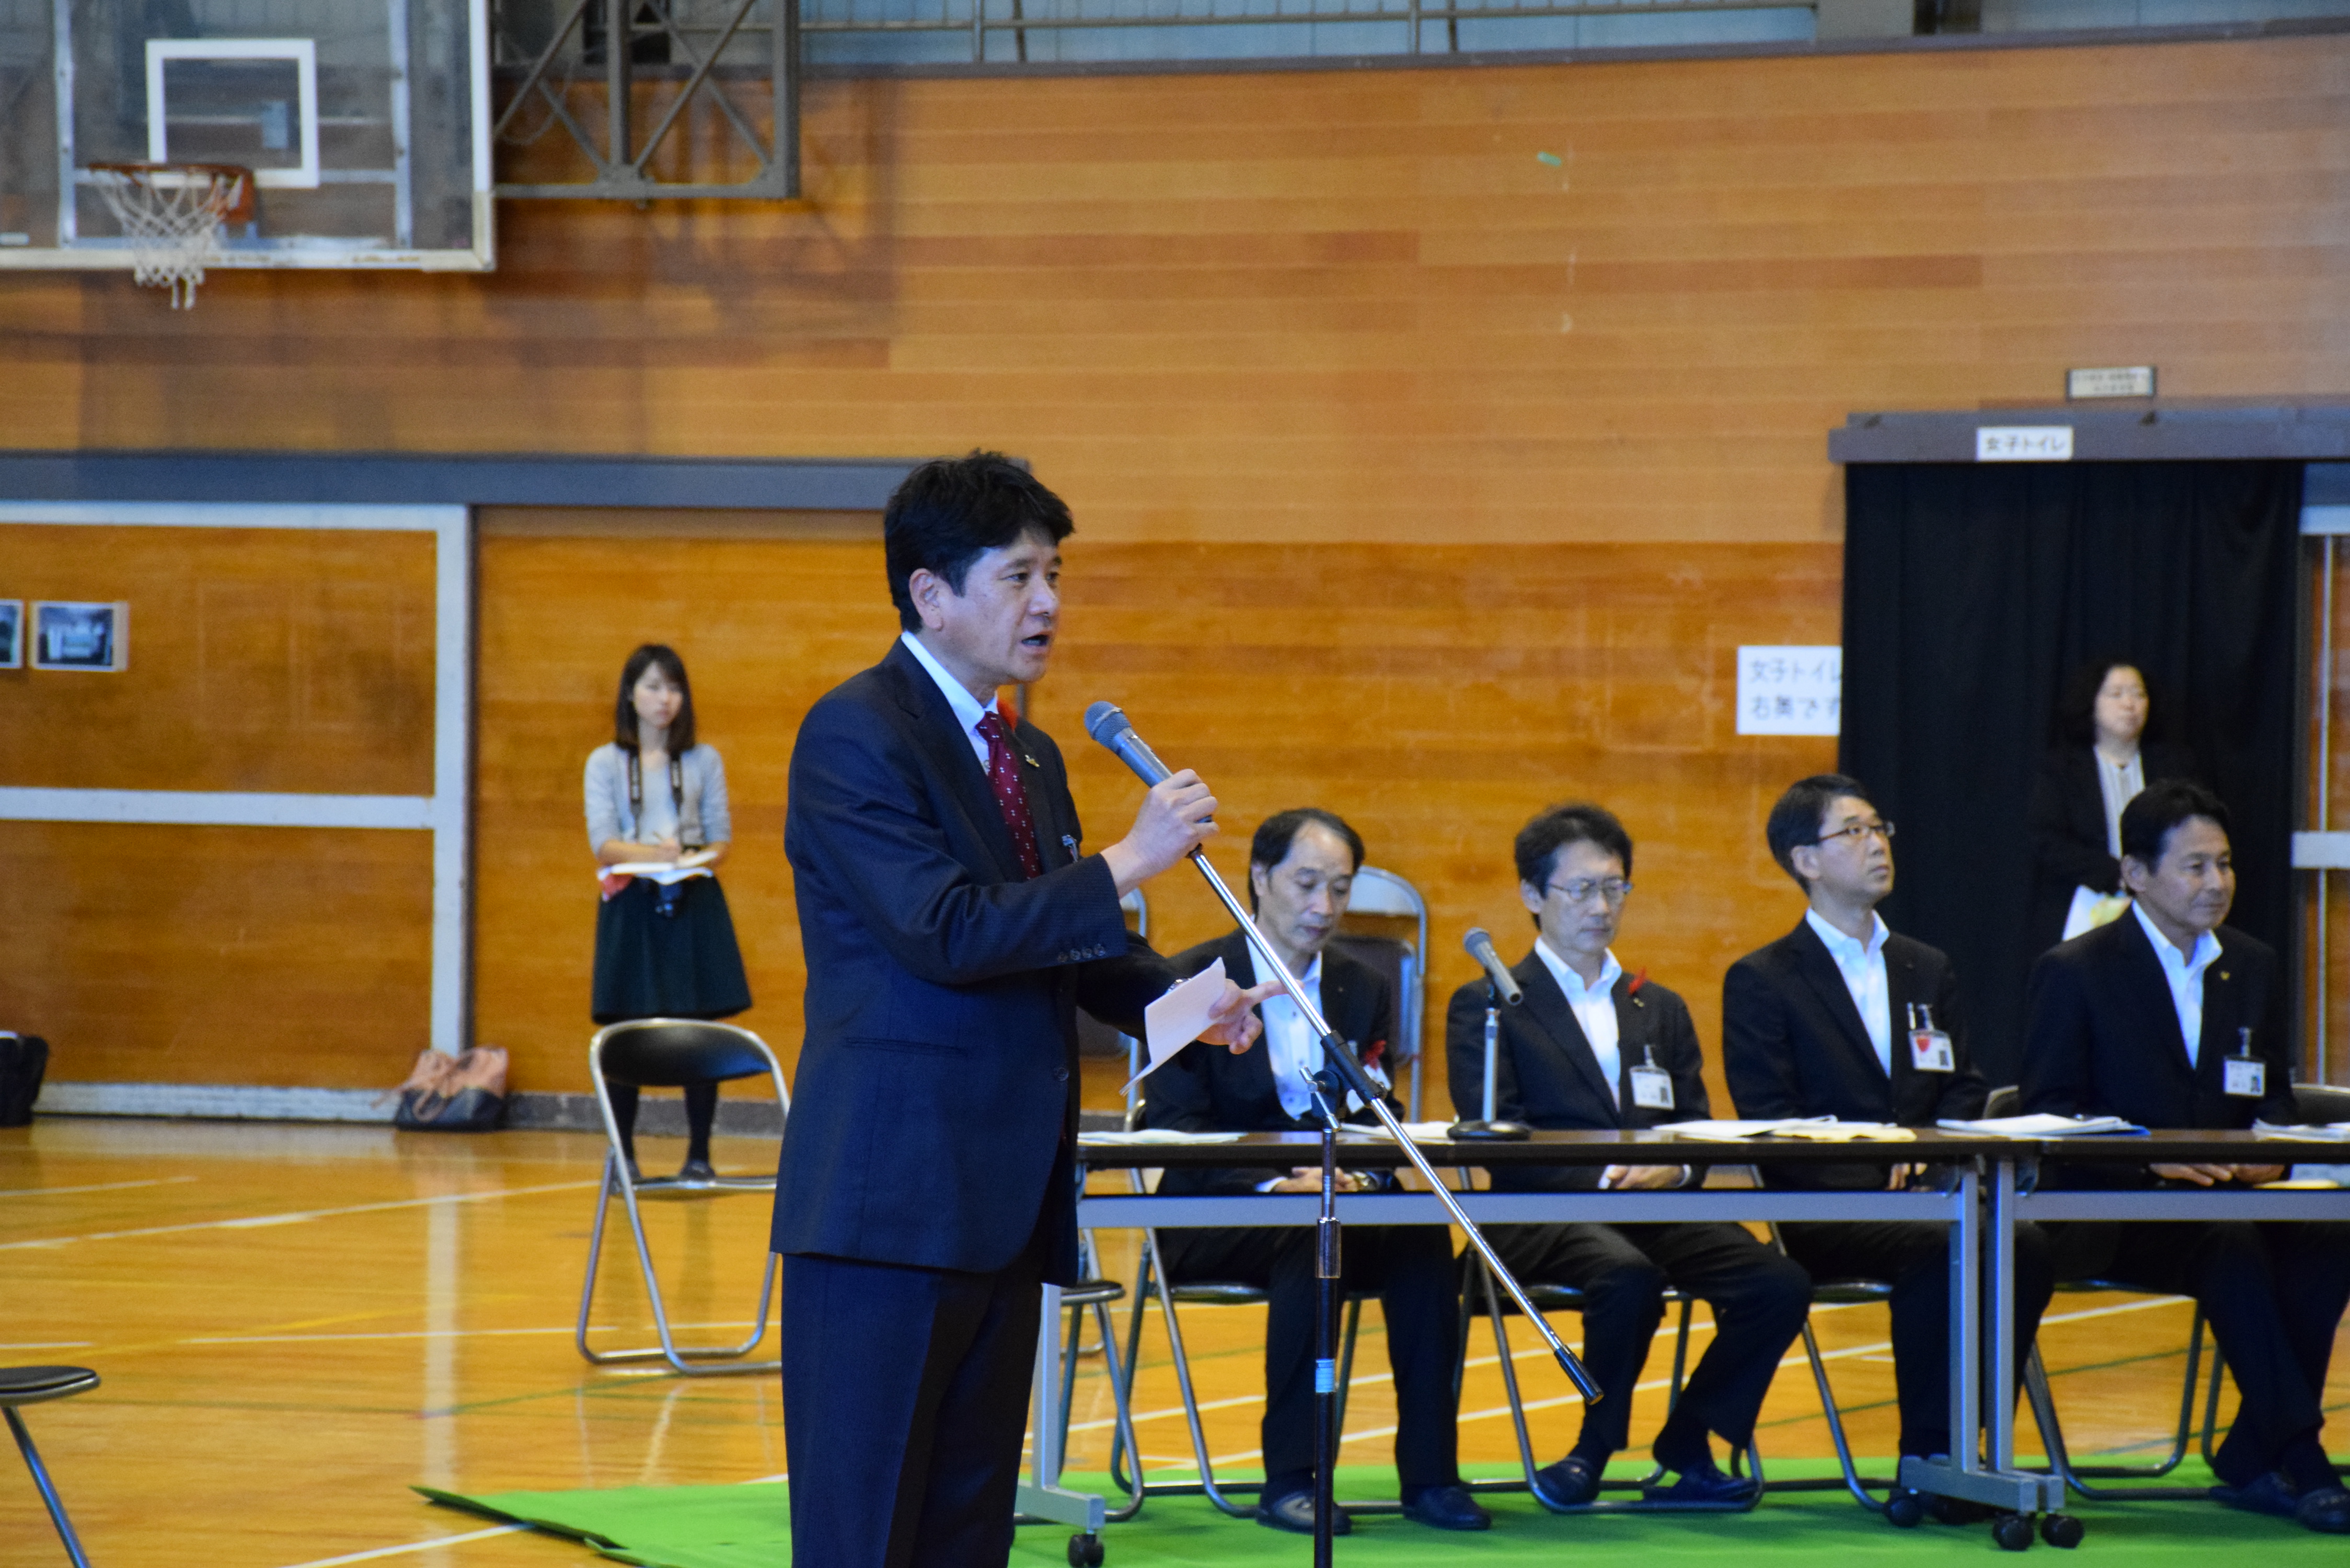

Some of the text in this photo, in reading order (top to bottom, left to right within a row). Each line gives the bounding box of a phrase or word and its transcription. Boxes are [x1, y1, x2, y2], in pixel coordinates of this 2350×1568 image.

[1985, 434, 2066, 454] 女子トイレ
